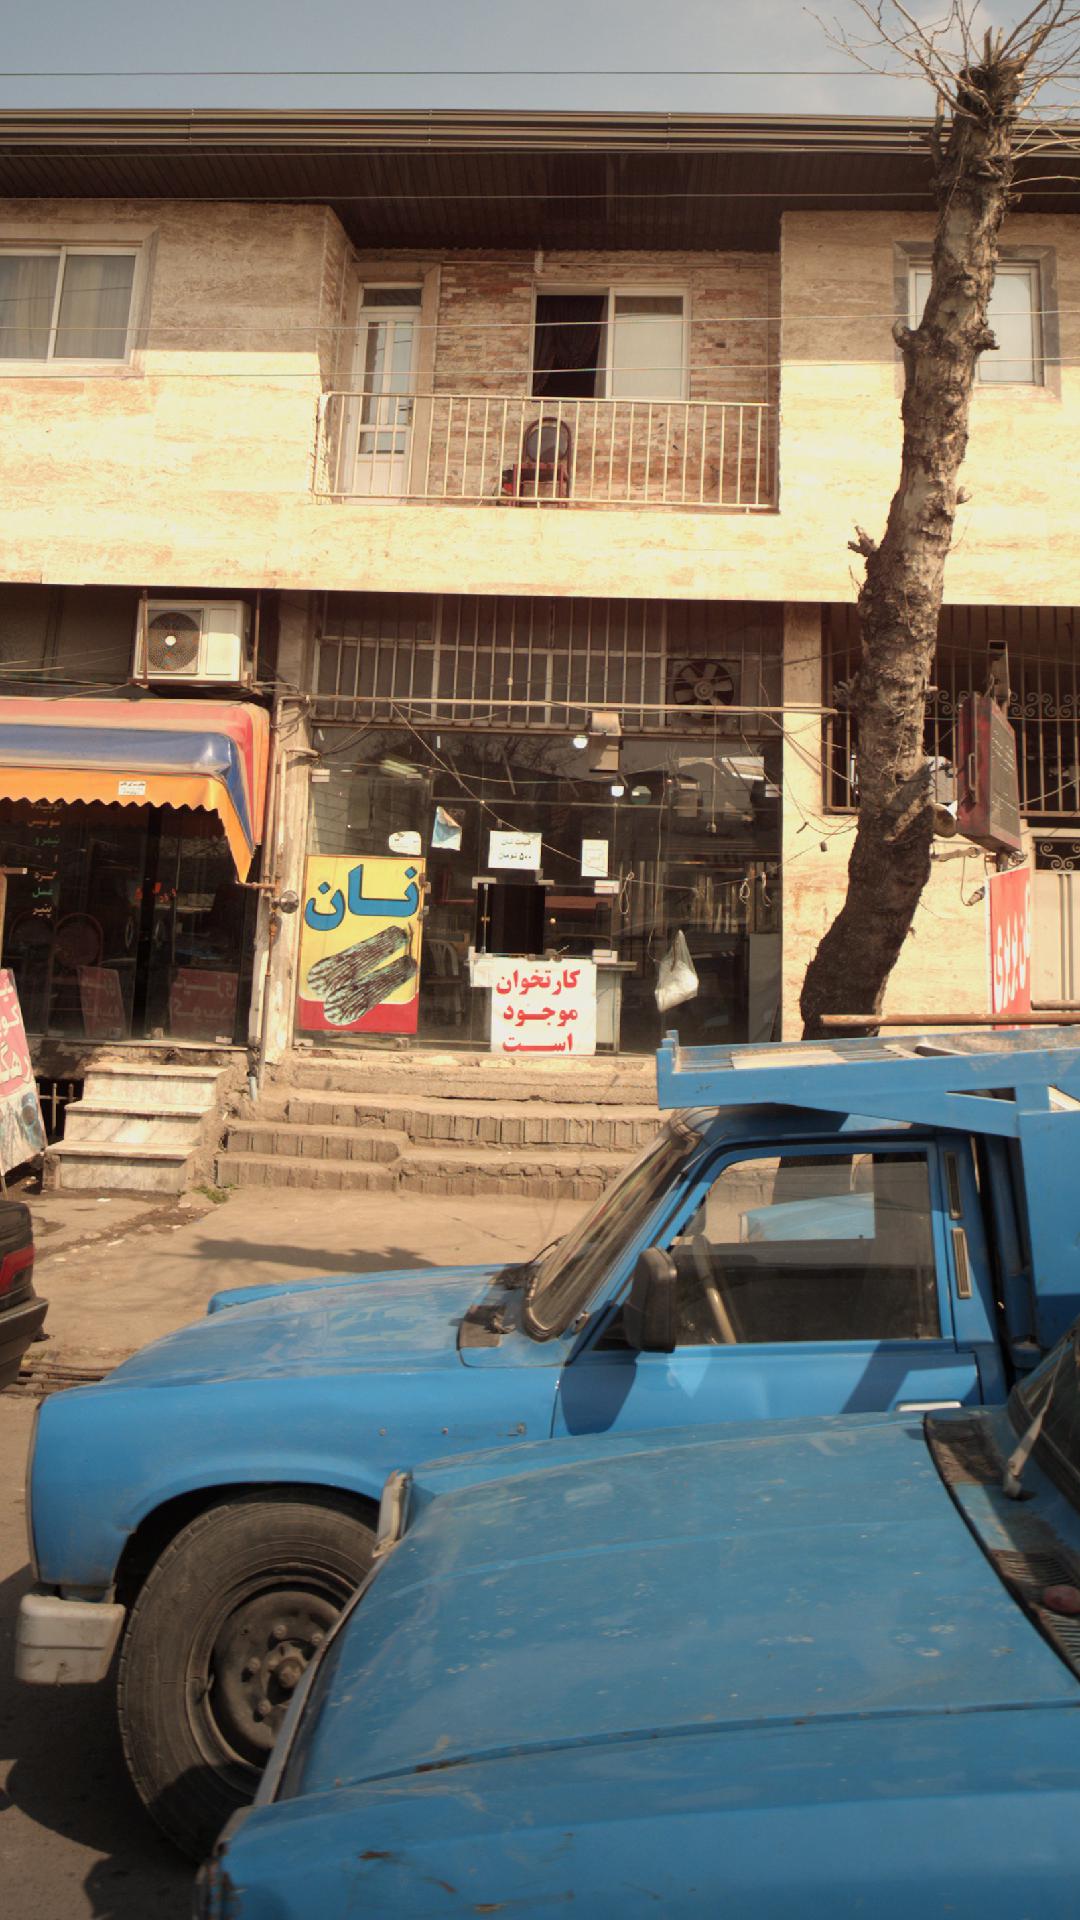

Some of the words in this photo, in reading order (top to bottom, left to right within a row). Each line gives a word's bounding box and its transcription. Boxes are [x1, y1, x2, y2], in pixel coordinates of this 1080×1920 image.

[304, 863, 420, 931] نان
[496, 968, 581, 996] کارتخوان
[503, 1004, 578, 1027] موجود
[502, 1033, 573, 1052] است
